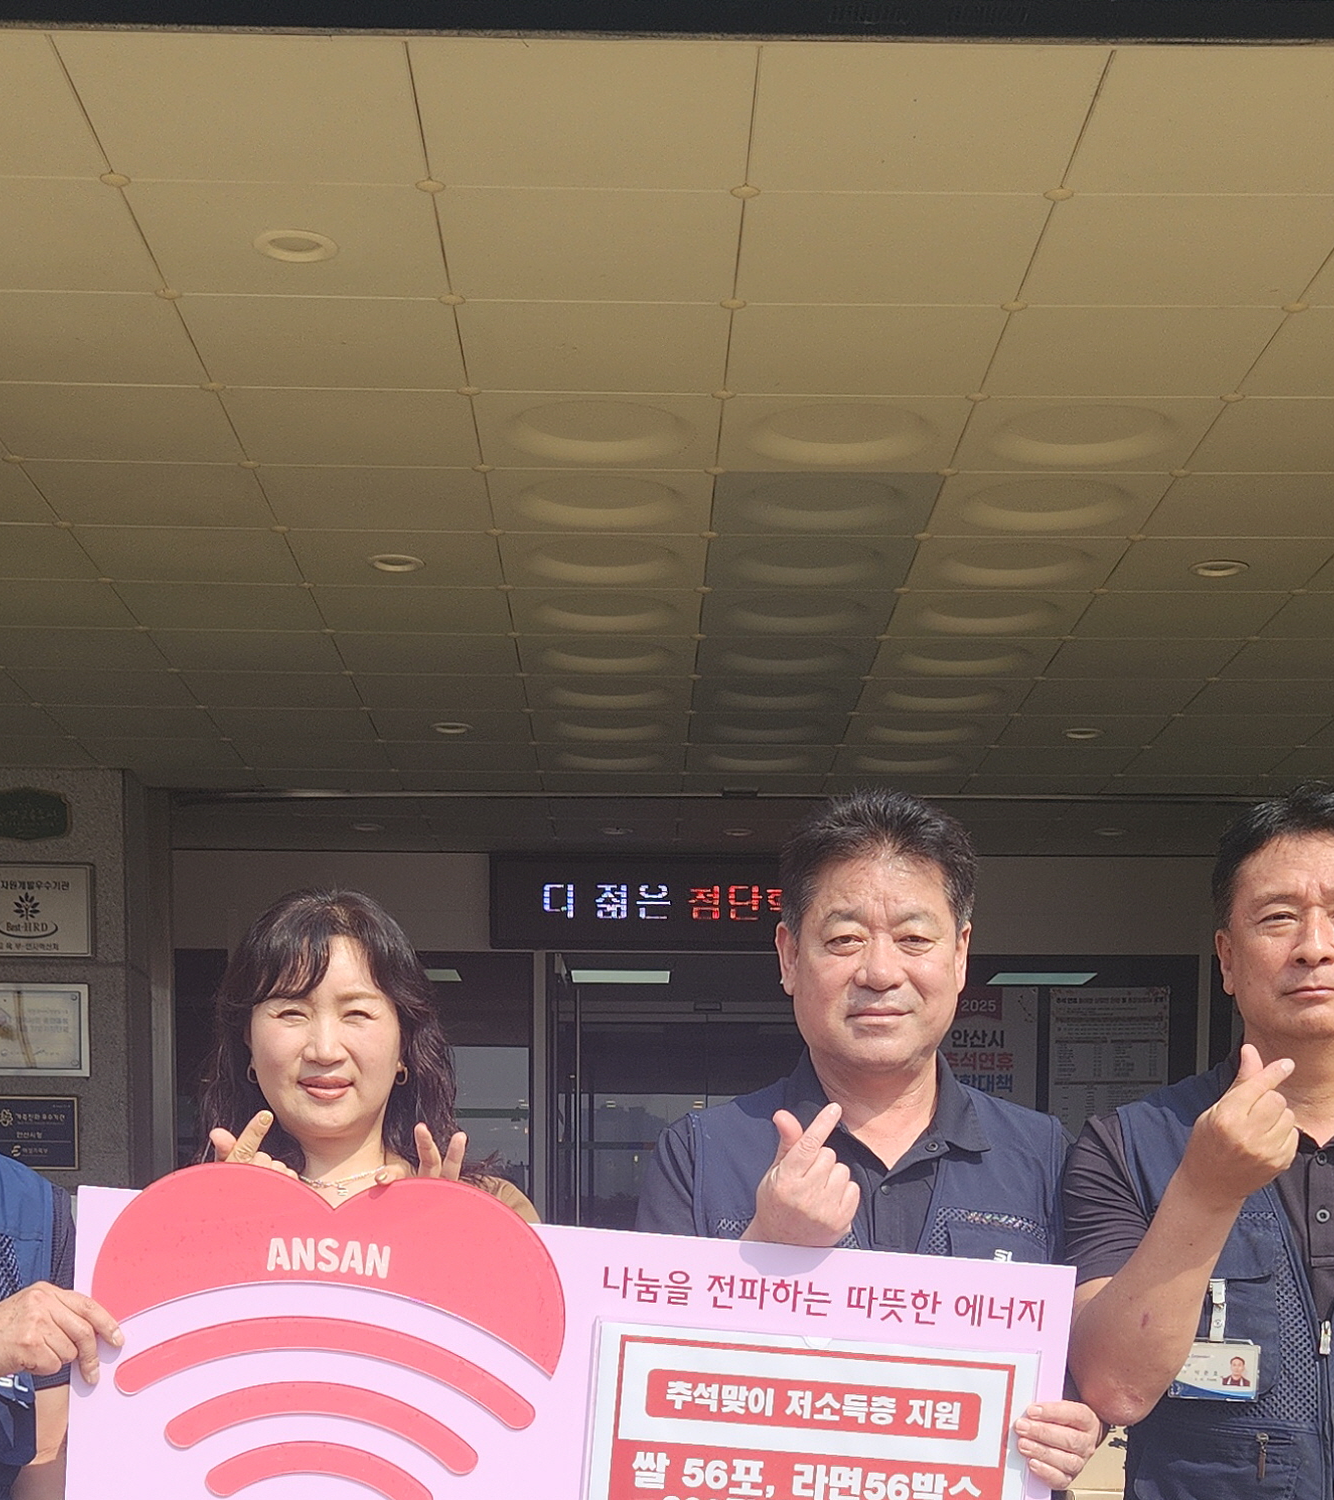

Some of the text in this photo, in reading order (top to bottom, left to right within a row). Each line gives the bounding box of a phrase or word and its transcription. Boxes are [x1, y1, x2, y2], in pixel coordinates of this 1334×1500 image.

[960, 1000, 997, 1013] 2025
[951, 1028, 1005, 1049] 안산시
[267, 1237, 391, 1279] ANSAN
[602, 1266, 1046, 1331] 나눔을 전파하는 따뜻한 에너지
[665, 1380, 962, 1431] 추석맞이 저소득층 지원
[632, 1450, 670, 1490] 쌀
[681, 1458, 775, 1498] 56포,
